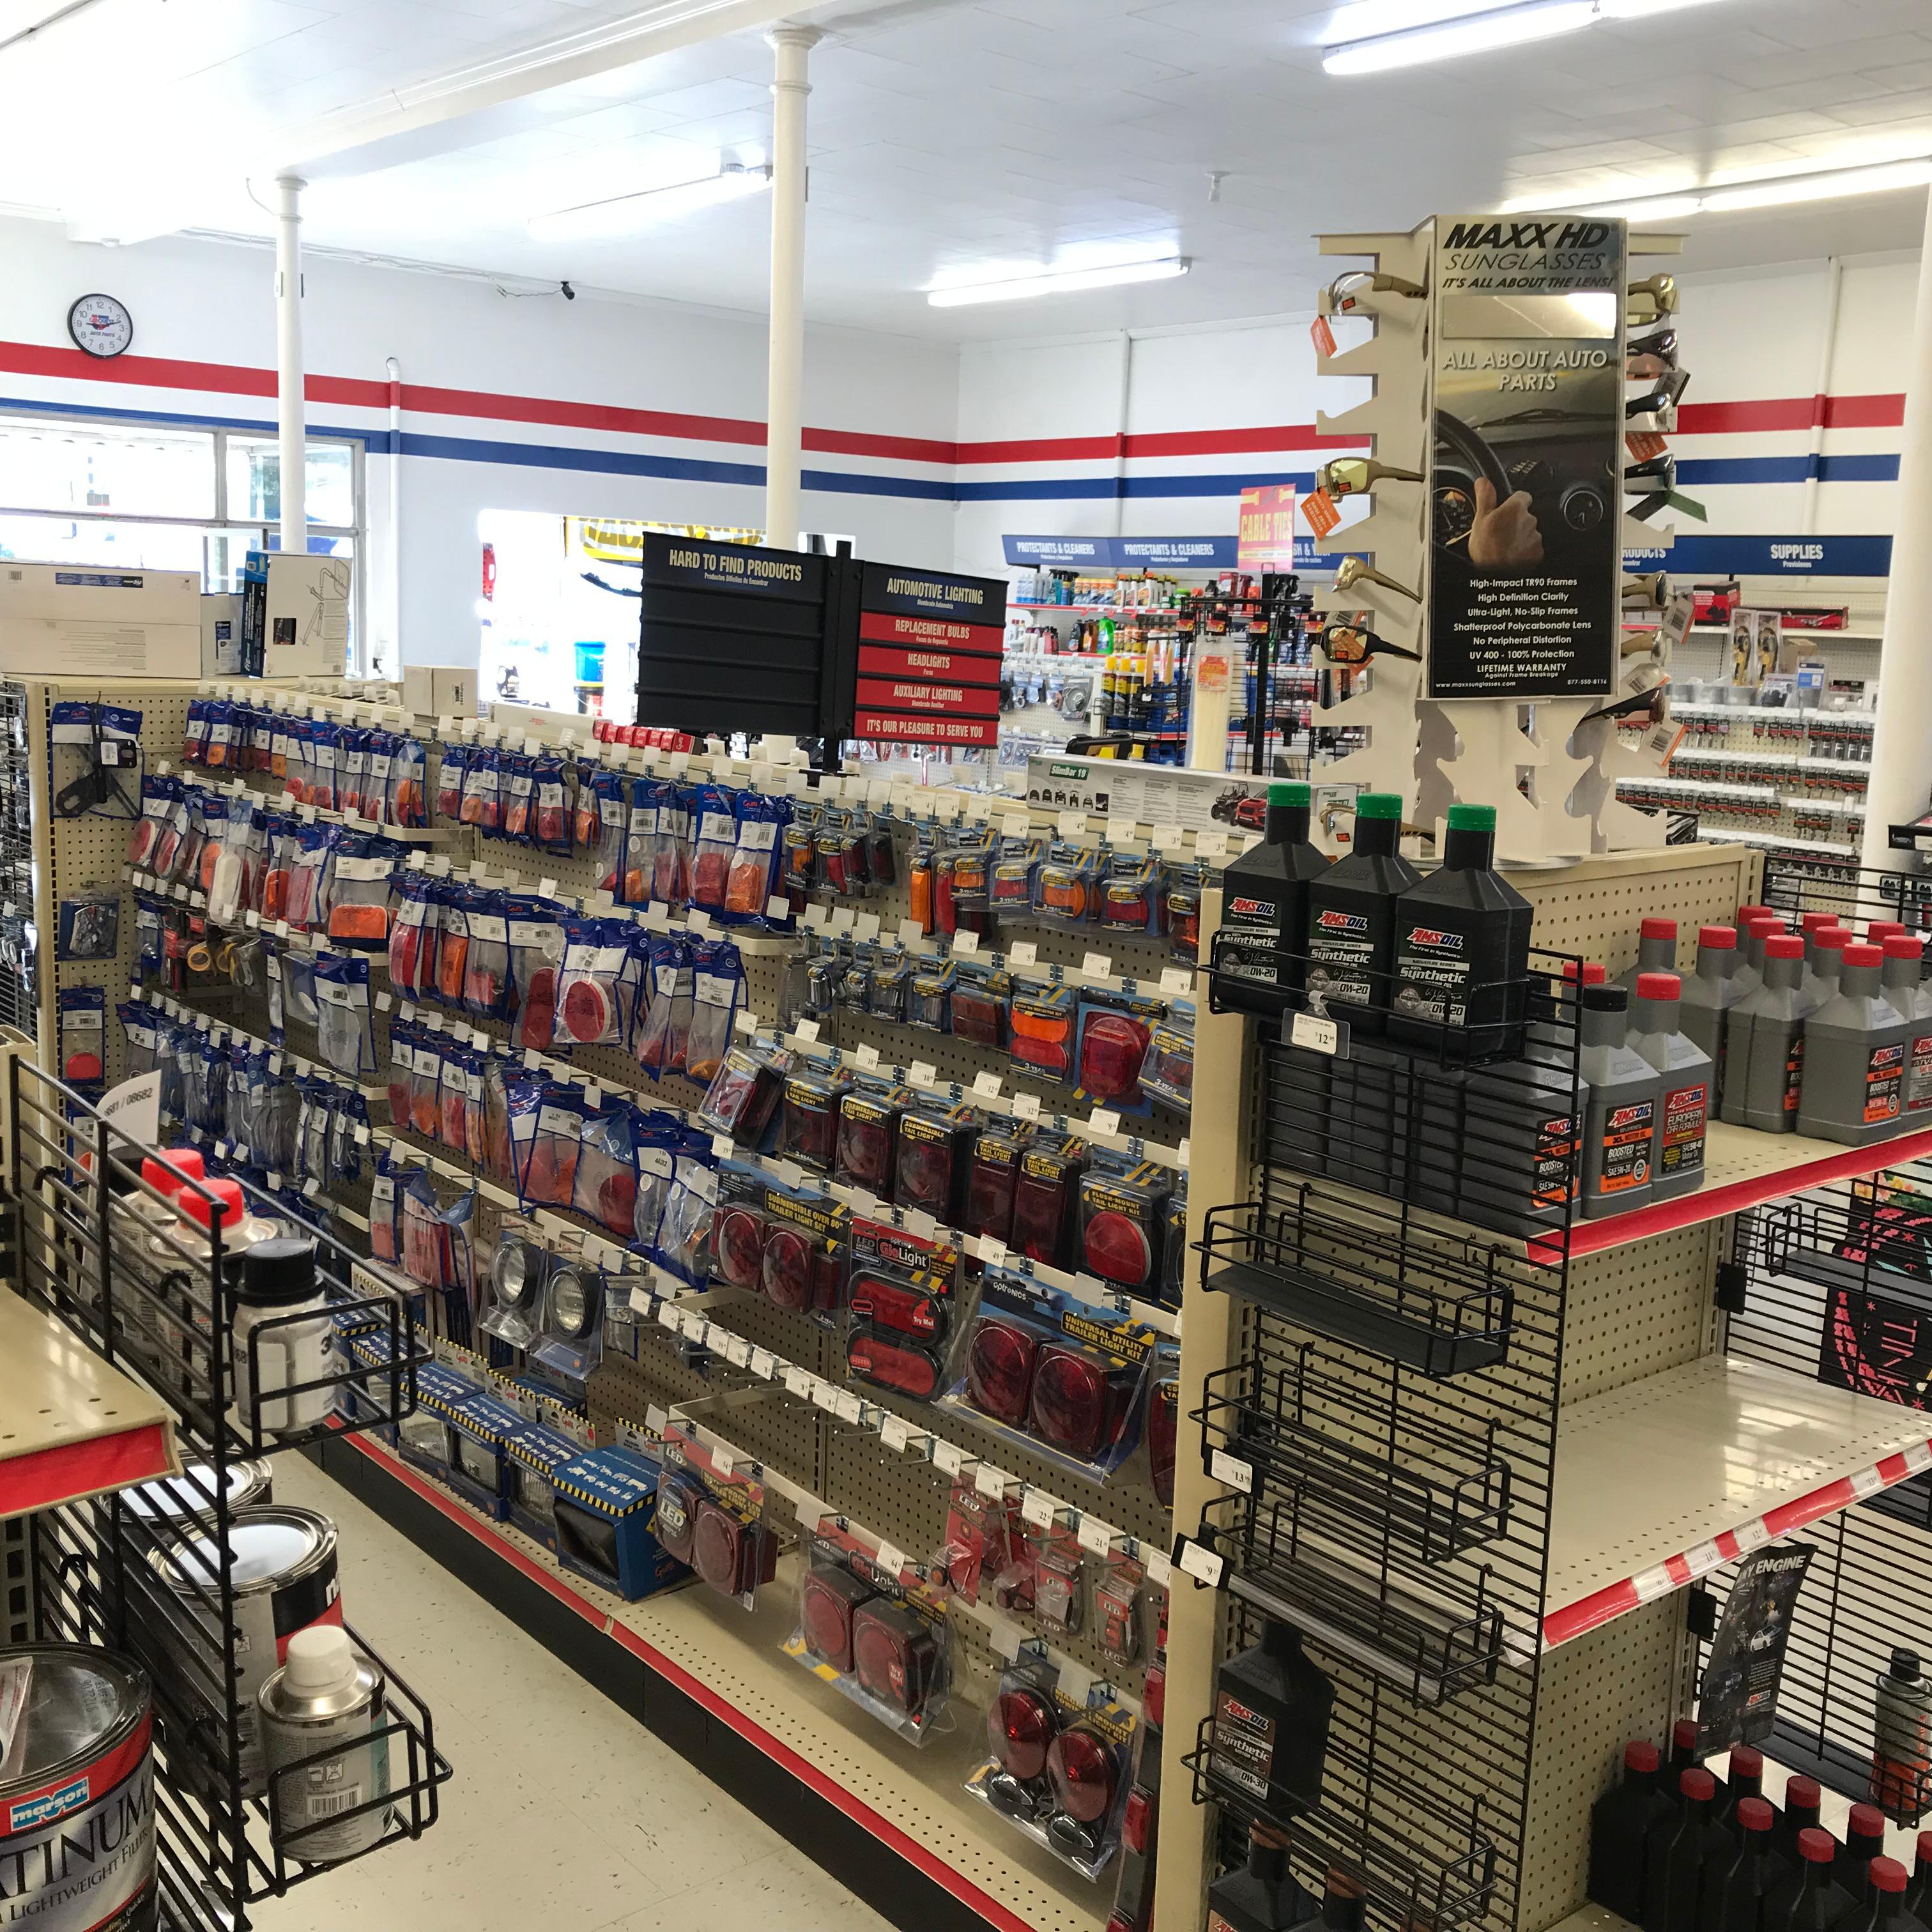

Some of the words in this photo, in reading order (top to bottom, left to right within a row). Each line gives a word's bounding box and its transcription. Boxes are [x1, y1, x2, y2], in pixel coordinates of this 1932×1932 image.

[1443, 223, 1559, 249] MAXX
[1554, 223, 1609, 249] HD
[1445, 252, 1606, 271] SUNGLASSES
[1443, 277, 1466, 288] IT'S
[1468, 277, 1493, 288] ALL
[1495, 277, 1546, 288] ABOUT
[1547, 277, 1574, 288] THE
[1442, 351, 1477, 370] ALL
[1482, 350, 1551, 369] ABOUT
[1552, 349, 1607, 368] AUTO
[1499, 373, 1557, 392] PARTS
[1241, 513, 1271, 542] CABLE
[1273, 511, 1292, 542] TIES
[1016, 541, 1057, 554] PROTECTANTS
[1058, 543, 1063, 554] &
[1064, 543, 1095, 555] CLEANERS
[1124, 543, 1170, 556] PROTECTANTS
[1171, 544, 1177, 556] &
[1179, 543, 1214, 556] CLEANERS
[1770, 544, 1823, 560] SUPPLIES
[670, 549, 700, 569] HARD
[703, 553, 716, 571] TO
[719, 556, 744, 574] FIND
[747, 559, 802, 581] PRODUCTS
[887, 578, 942, 599] AUTOMOTIVE
[945, 586, 984, 605] LIGHTING
[1470, 578, 1524, 589] High-Impact
[1526, 578, 1545, 586] TR90
[1547, 578, 1577, 586] Frames
[1478, 593, 1498, 603] High
[1500, 593, 1539, 601] Definition
[1541, 592, 1569, 602] Clarity
[1468, 608, 1512, 618] Ultra-Light,
[1515, 607, 1545, 617] No-Slip
[1547, 606, 1578, 615] Frames
[895, 619, 946, 636] REPLACEMENT
[947, 625, 970, 640] BULBS
[1453, 622, 1506, 632] Shatterproof
[1508, 621, 1570, 631] Polycarbonate
[1572, 620, 1591, 629] Lens
[1487, 636, 1531, 646] Peripheral
[1533, 636, 1572, 644] Distortion
[907, 653, 950, 670] HEADLIGHTS
[1508, 650, 1529, 659] 100%
[1532, 650, 1575, 659] Protection
[1477, 664, 1514, 673] LIFETIME
[1517, 663, 1567, 672] WARRANTY
[893, 684, 930, 699] AUXILIARY
[931, 688, 963, 702] LIGHTING
[867, 719, 881, 732] IT'S
[882, 720, 898, 733] OUR
[899, 721, 935, 735] PLEASURE
[936, 724, 945, 736] TO
[947, 724, 969, 737] SERVE
[970, 726, 983, 738] YOU
[1051, 765, 1077, 777] SlimBar
[1077, 767, 1086, 778] 19
[1229, 897, 1275, 917] AMSOIL
[1316, 910, 1368, 931] AMSOIL
[1406, 927, 1464, 949] AMSOIL
[1310, 948, 1370, 963] Synthetic
[1250, 967, 1275, 978] 0W-20
[1399, 967, 1466, 984] Synthetic
[1340, 983, 1368, 995] 0W-20
[789, 1092, 800, 1101] TAIL
[801, 1096, 816, 1106] LIGHT
[1669, 1087, 1704, 1110] AMSOIL
[845, 1108, 855, 1117] TAIL
[856, 1112, 873, 1121] LIGHT
[1608, 1102, 1652, 1128] AMSOIL
[1667, 1108, 1703, 1126] EUROPEAN
[904, 1127, 916, 1135] TAIL
[917, 1131, 935, 1141] LIGHT
[1666, 1124, 1678, 1135] CAR
[1678, 1119, 1703, 1133] FORMULA
[993, 1151, 1011, 1160] LIGHT
[1607, 1144, 1634, 1159] BOOSTED
[1041, 1167, 1059, 1177] LIGHT
[1607, 1167, 1618, 1177] SAE
[1092, 1190, 1140, 1209] FLUSH-MOUNT
[1092, 1197, 1107, 1206] TAIL
[1108, 1201, 1127, 1213] LIGHT
[1128, 1208, 1140, 1216] KIT
[767, 1193, 811, 1218] SUBMERSIBLE
[813, 1211, 829, 1225] OVER
[767, 1203, 797, 1220] TRAILER
[798, 1214, 813, 1227] LIGHT
[815, 1222, 826, 1232] SET
[856, 1236, 875, 1246] LED
[880, 1241, 926, 1268] GloLight
[913, 1316, 922, 1325] Try
[1065, 1314, 1110, 1340] UNIVERSAL
[1112, 1333, 1144, 1353] UTILITY
[1065, 1322, 1098, 1342] TRAILER
[1100, 1337, 1125, 1354] LIGHT
[1126, 1347, 1142, 1361] KIT
[666, 1446, 684, 1464] LED
[659, 1498, 685, 1528] LED
[1756, 1555, 1807, 1574] ENGINE
[1223, 1699, 1269, 1731] AMSOIL
[1216, 1730, 1270, 1762] Synthetic
[1241, 1771, 1267, 1790] 0W-30
[12, 1786, 88, 1823] marson
[10, 1856, 119, 1922] LIGHTWEIGHT
